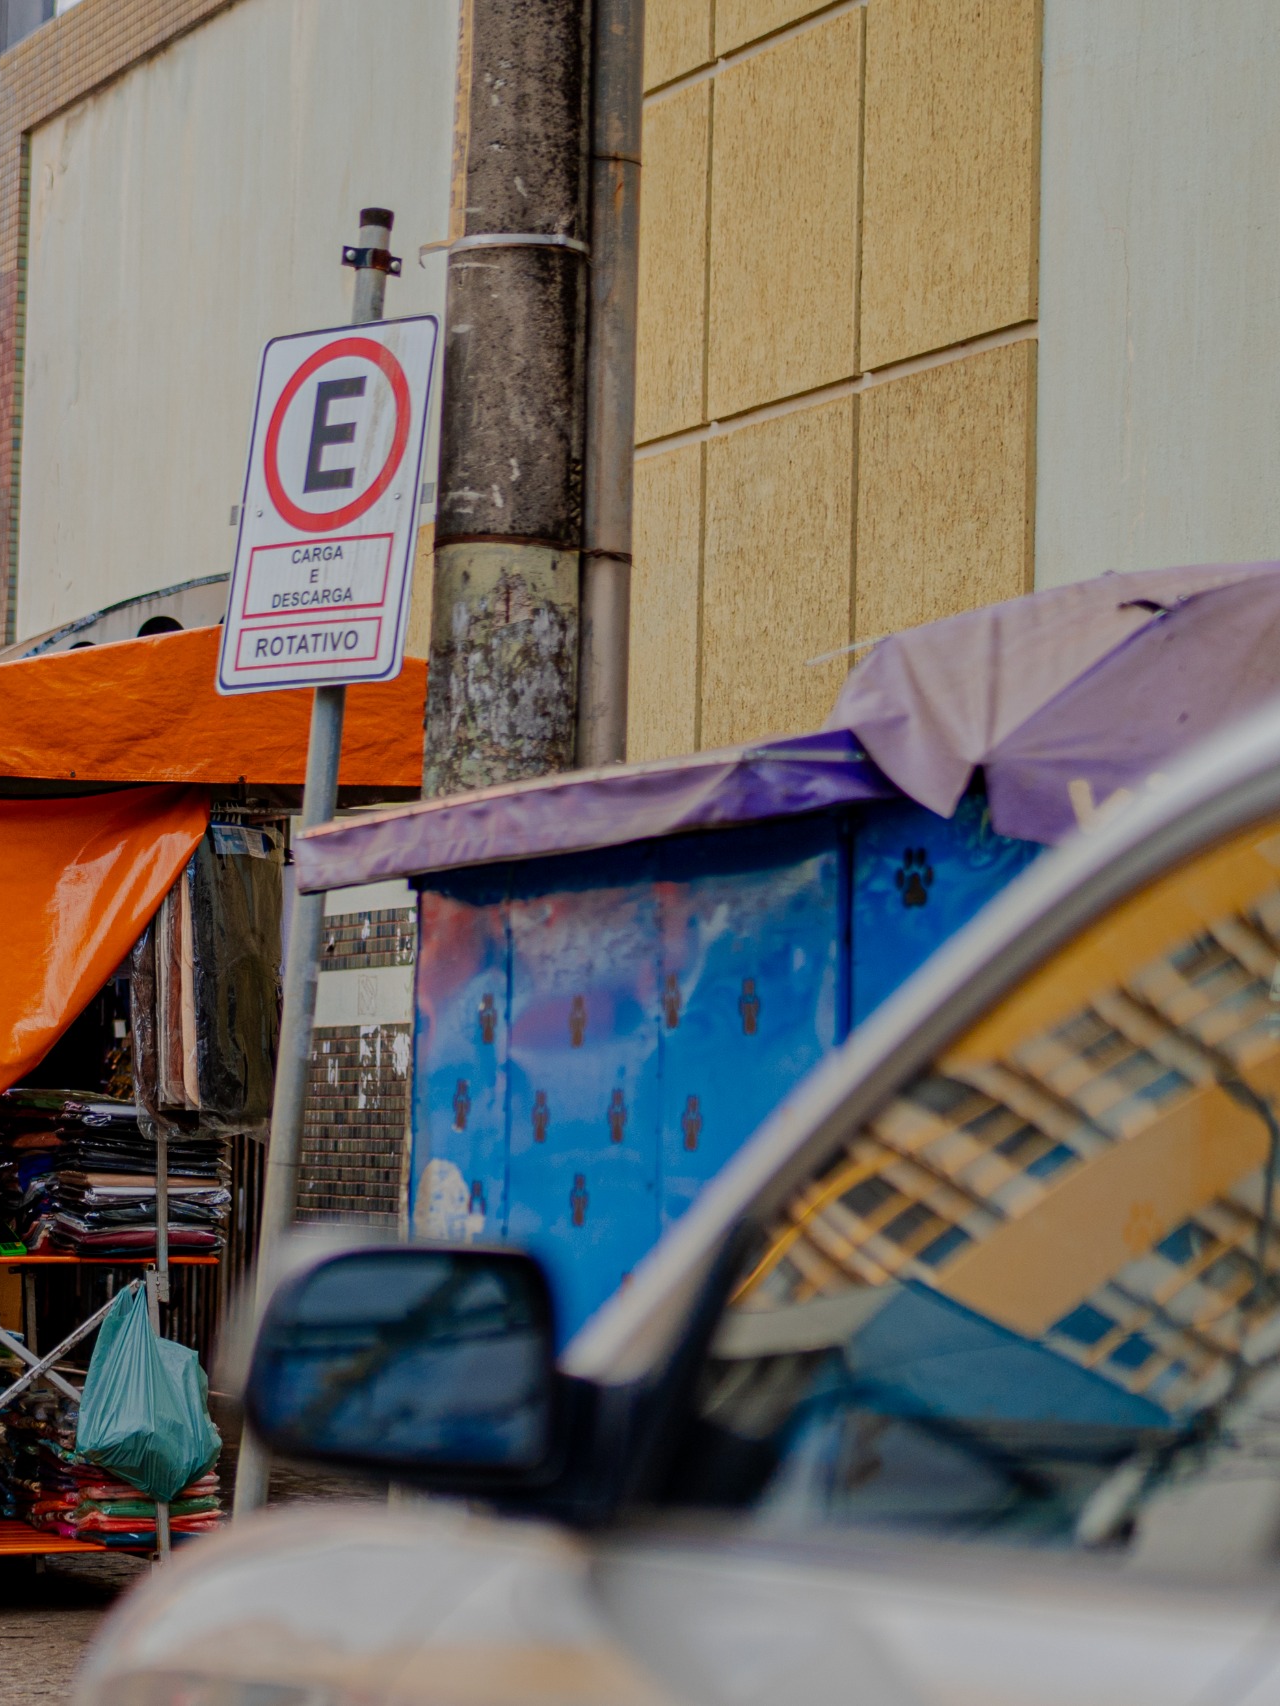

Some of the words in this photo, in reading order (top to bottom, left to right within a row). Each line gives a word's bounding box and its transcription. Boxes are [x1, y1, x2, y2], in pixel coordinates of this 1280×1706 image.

[303, 375, 367, 493] E
[291, 545, 344, 565] CARGA
[308, 568, 320, 584] E
[271, 587, 353, 609] DESCARGA
[254, 630, 359, 658] ROTATIVO
